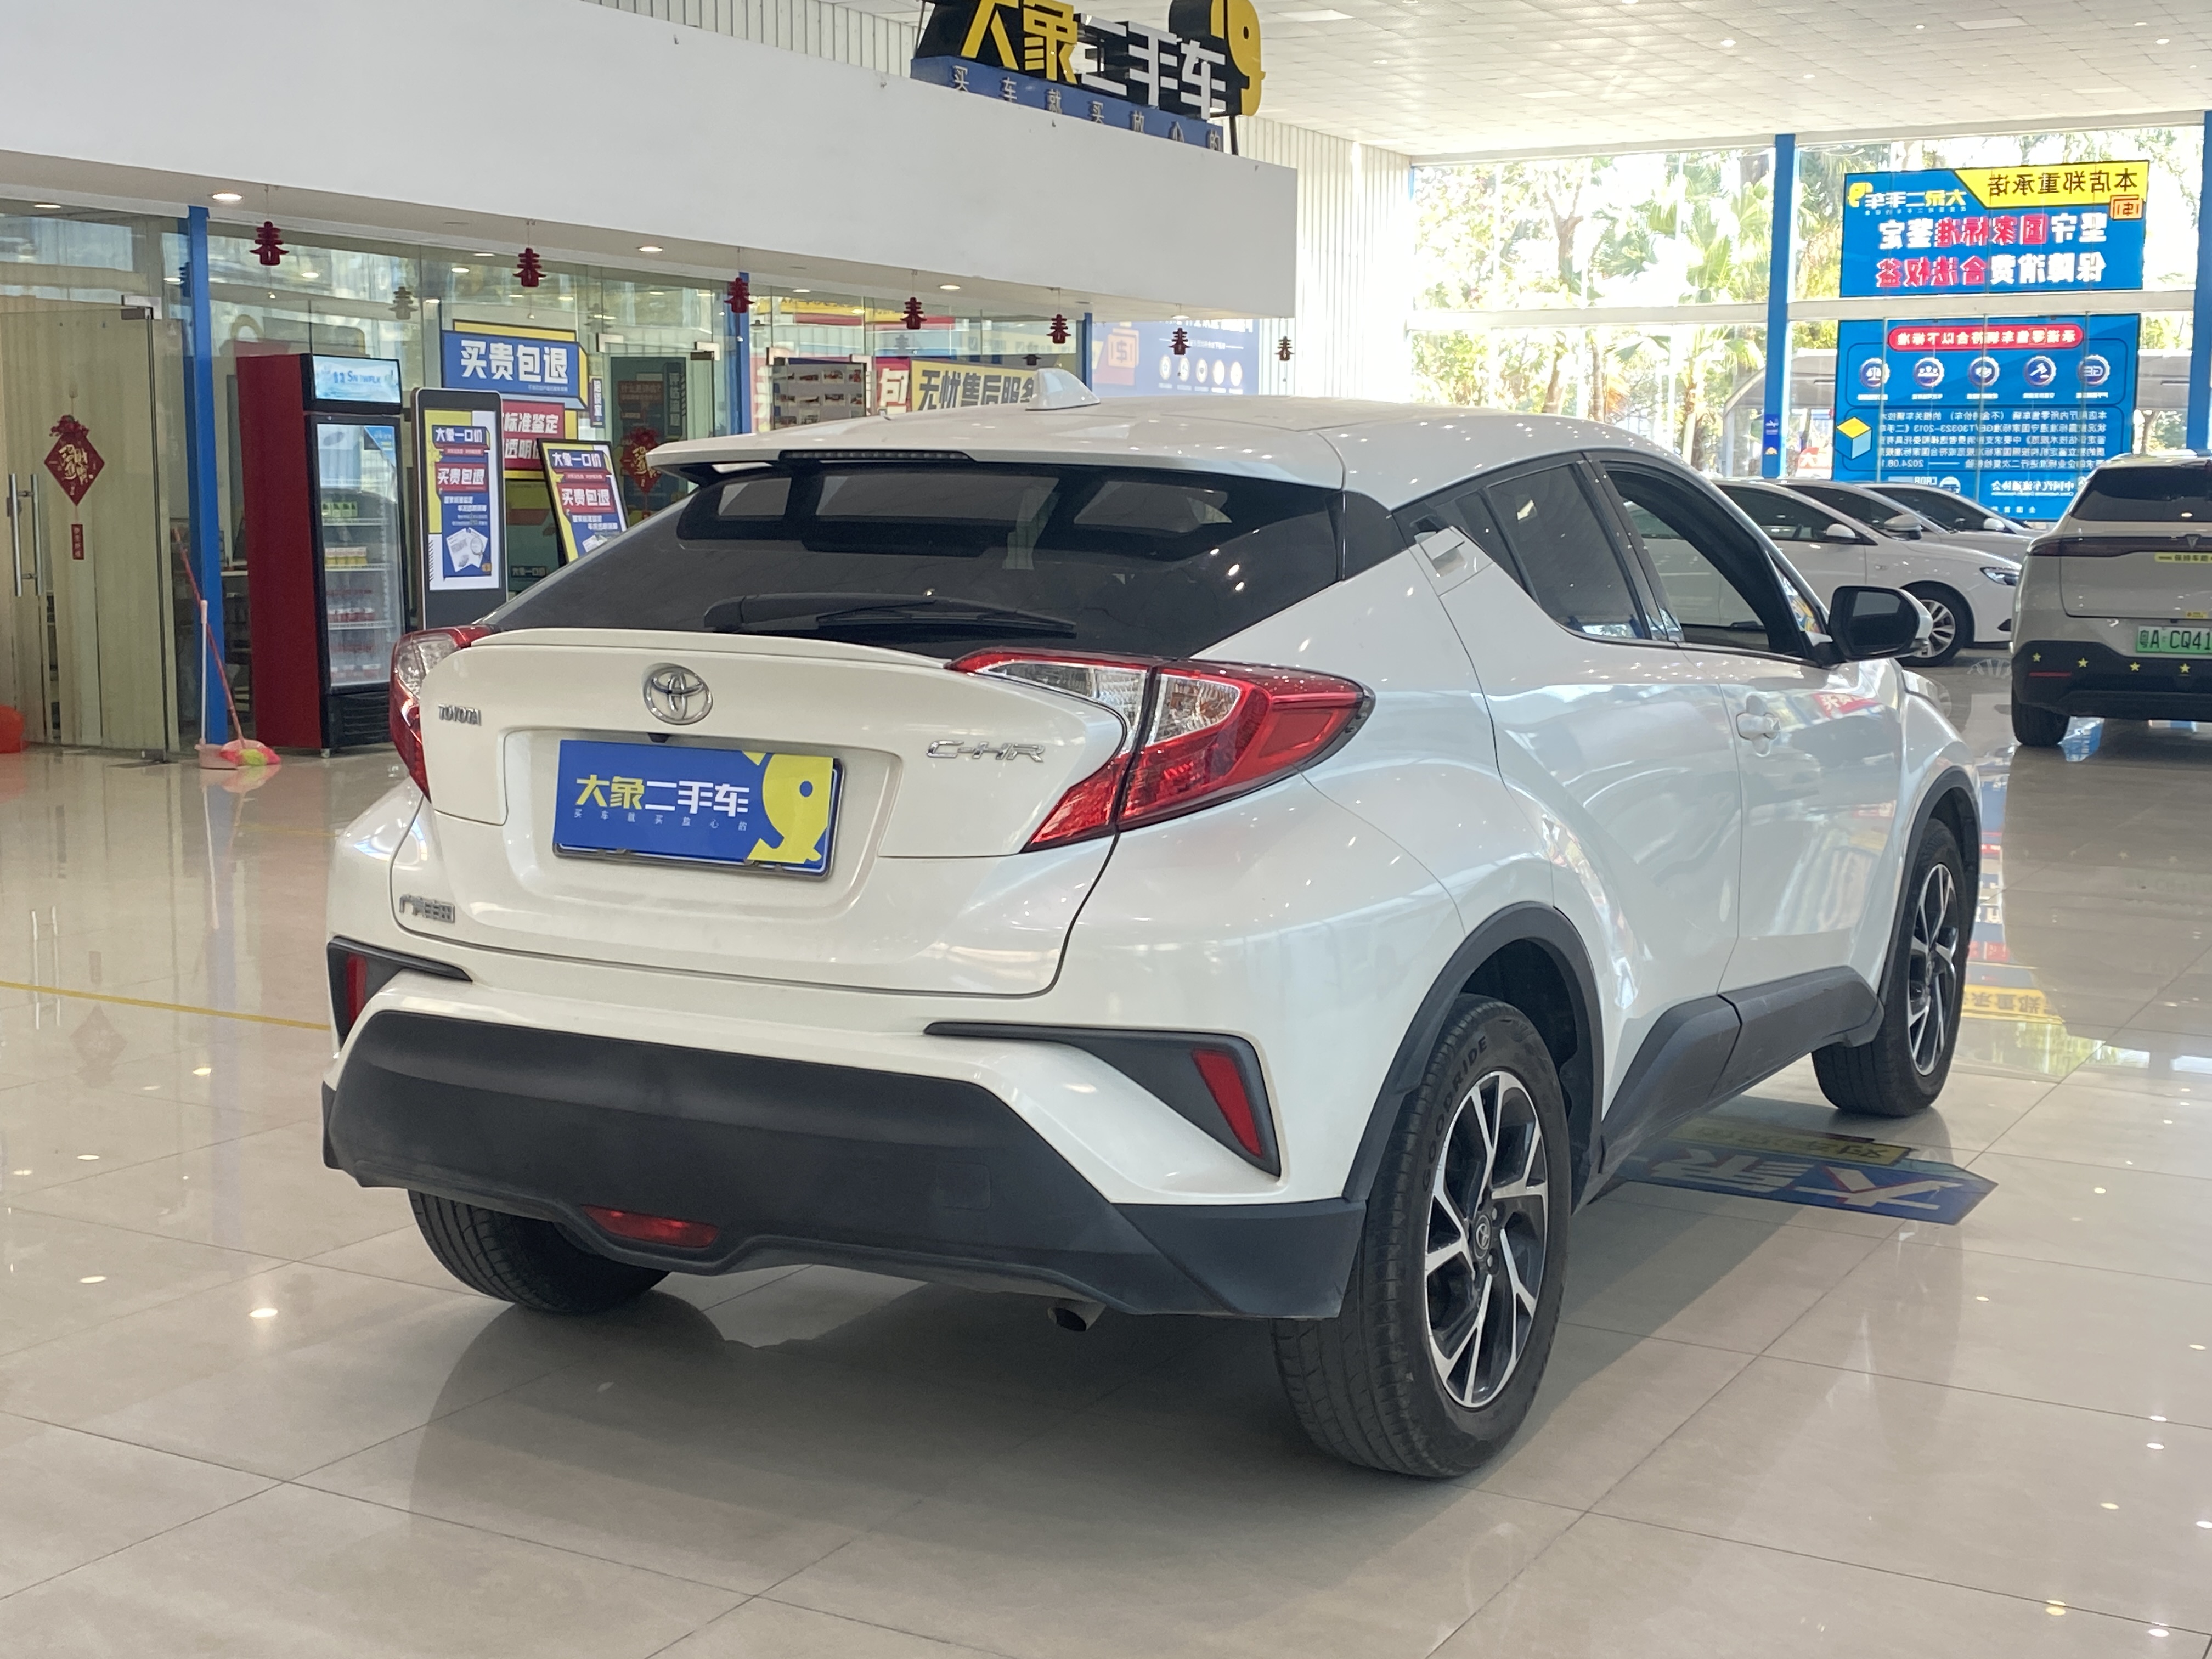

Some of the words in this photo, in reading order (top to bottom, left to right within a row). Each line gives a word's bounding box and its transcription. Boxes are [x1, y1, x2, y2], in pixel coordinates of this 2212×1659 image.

[961, 0, 1226, 120] 大象二手车
[460, 339, 568, 384] 买贵包退
[503, 412, 559, 434] 标准鉴定
[435, 428, 482, 443] 大象一口价
[552, 452, 602, 467] 大象一口价
[438, 468, 485, 485] 买贵包退
[561, 488, 611, 506] 买贵包退
[438, 704, 482, 726] TOYOTA
[926, 741, 1046, 763] C-HR
[575, 774, 751, 817] 大象二手车
[574, 808, 747, 832] 买车就买放心的
[399, 895, 455, 924] 广汽丰田
[1423, 1035, 1487, 1192] GOODRIDE
